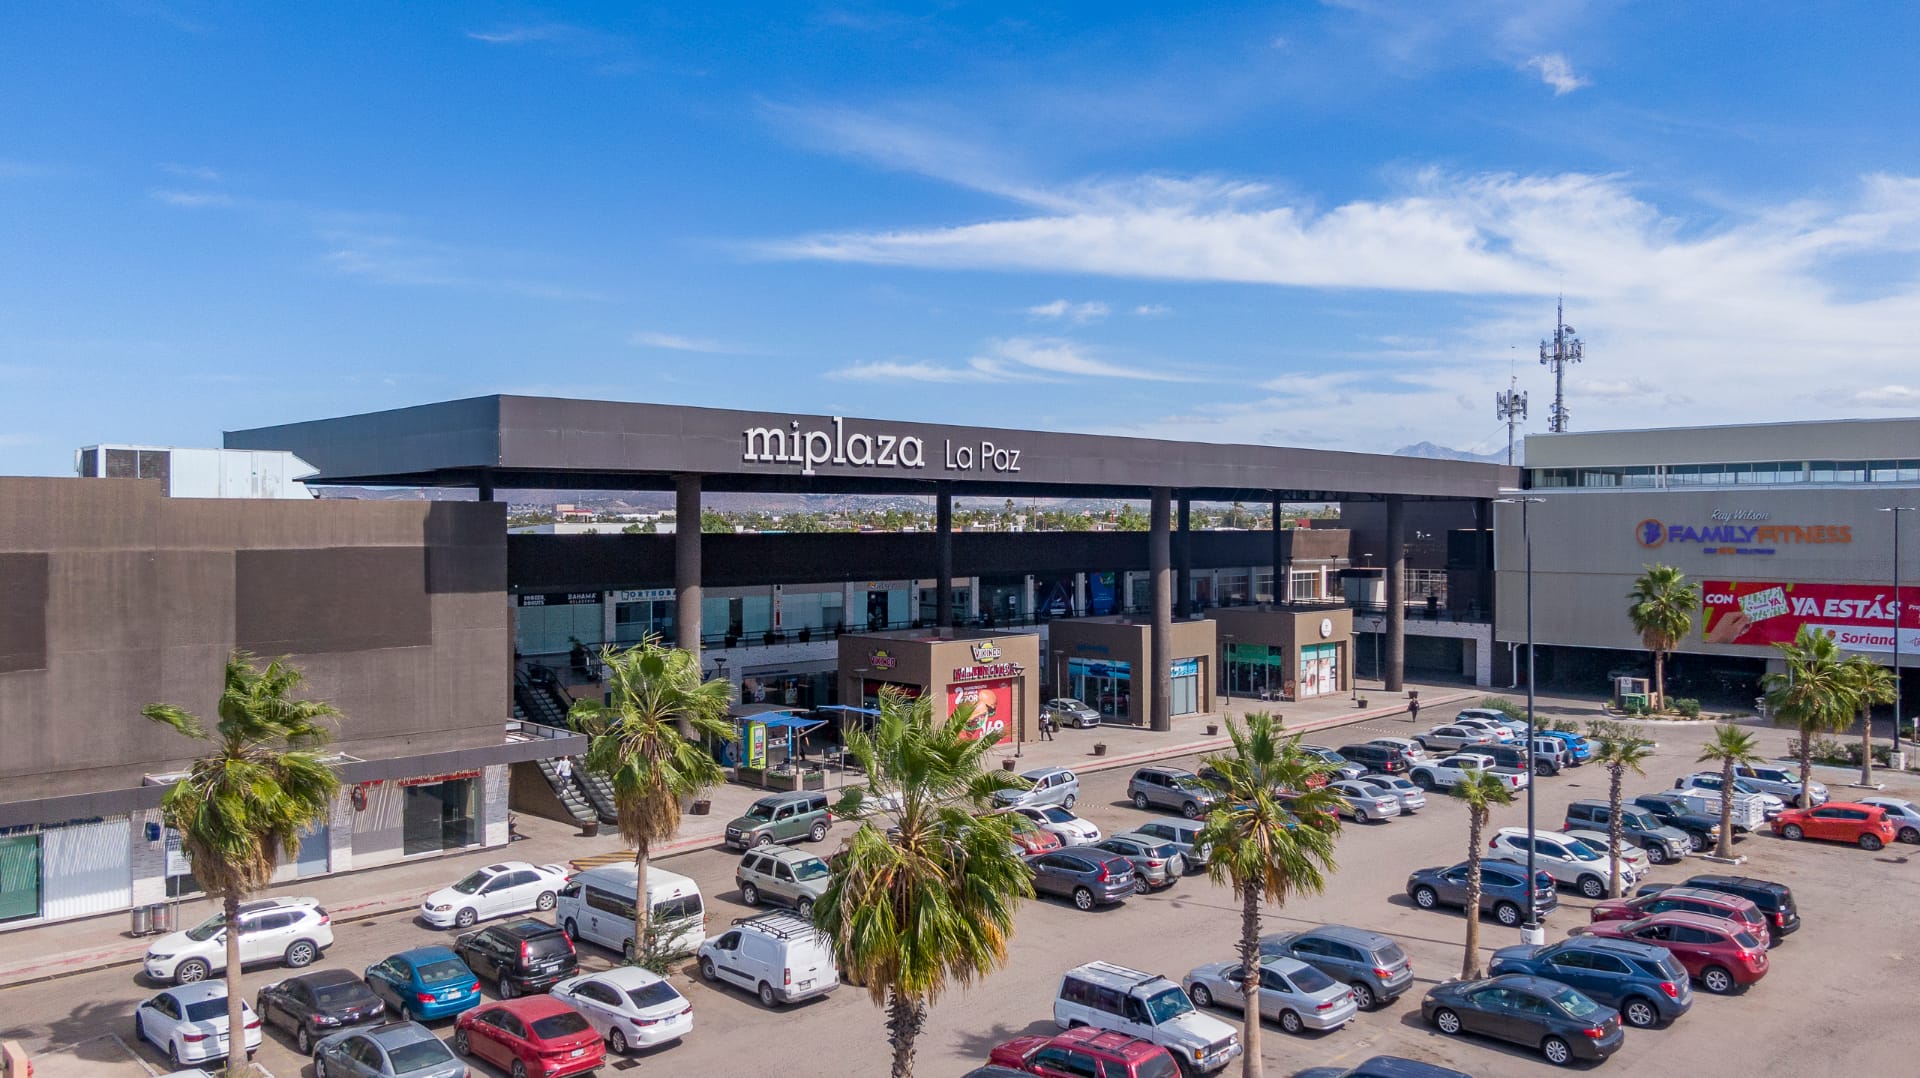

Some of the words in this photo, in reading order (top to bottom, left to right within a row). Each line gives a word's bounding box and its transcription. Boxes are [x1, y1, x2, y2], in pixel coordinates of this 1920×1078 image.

[743, 415, 925, 475] miplaza
[945, 439, 973, 469] La
[981, 441, 1021, 471] Paz
[1711, 509, 1732, 523] Ray
[1733, 508, 1770, 521] Wilson
[1705, 593, 1734, 605] CON
[1790, 597, 1820, 616] YA
[1822, 594, 1902, 620] ESTÁS
